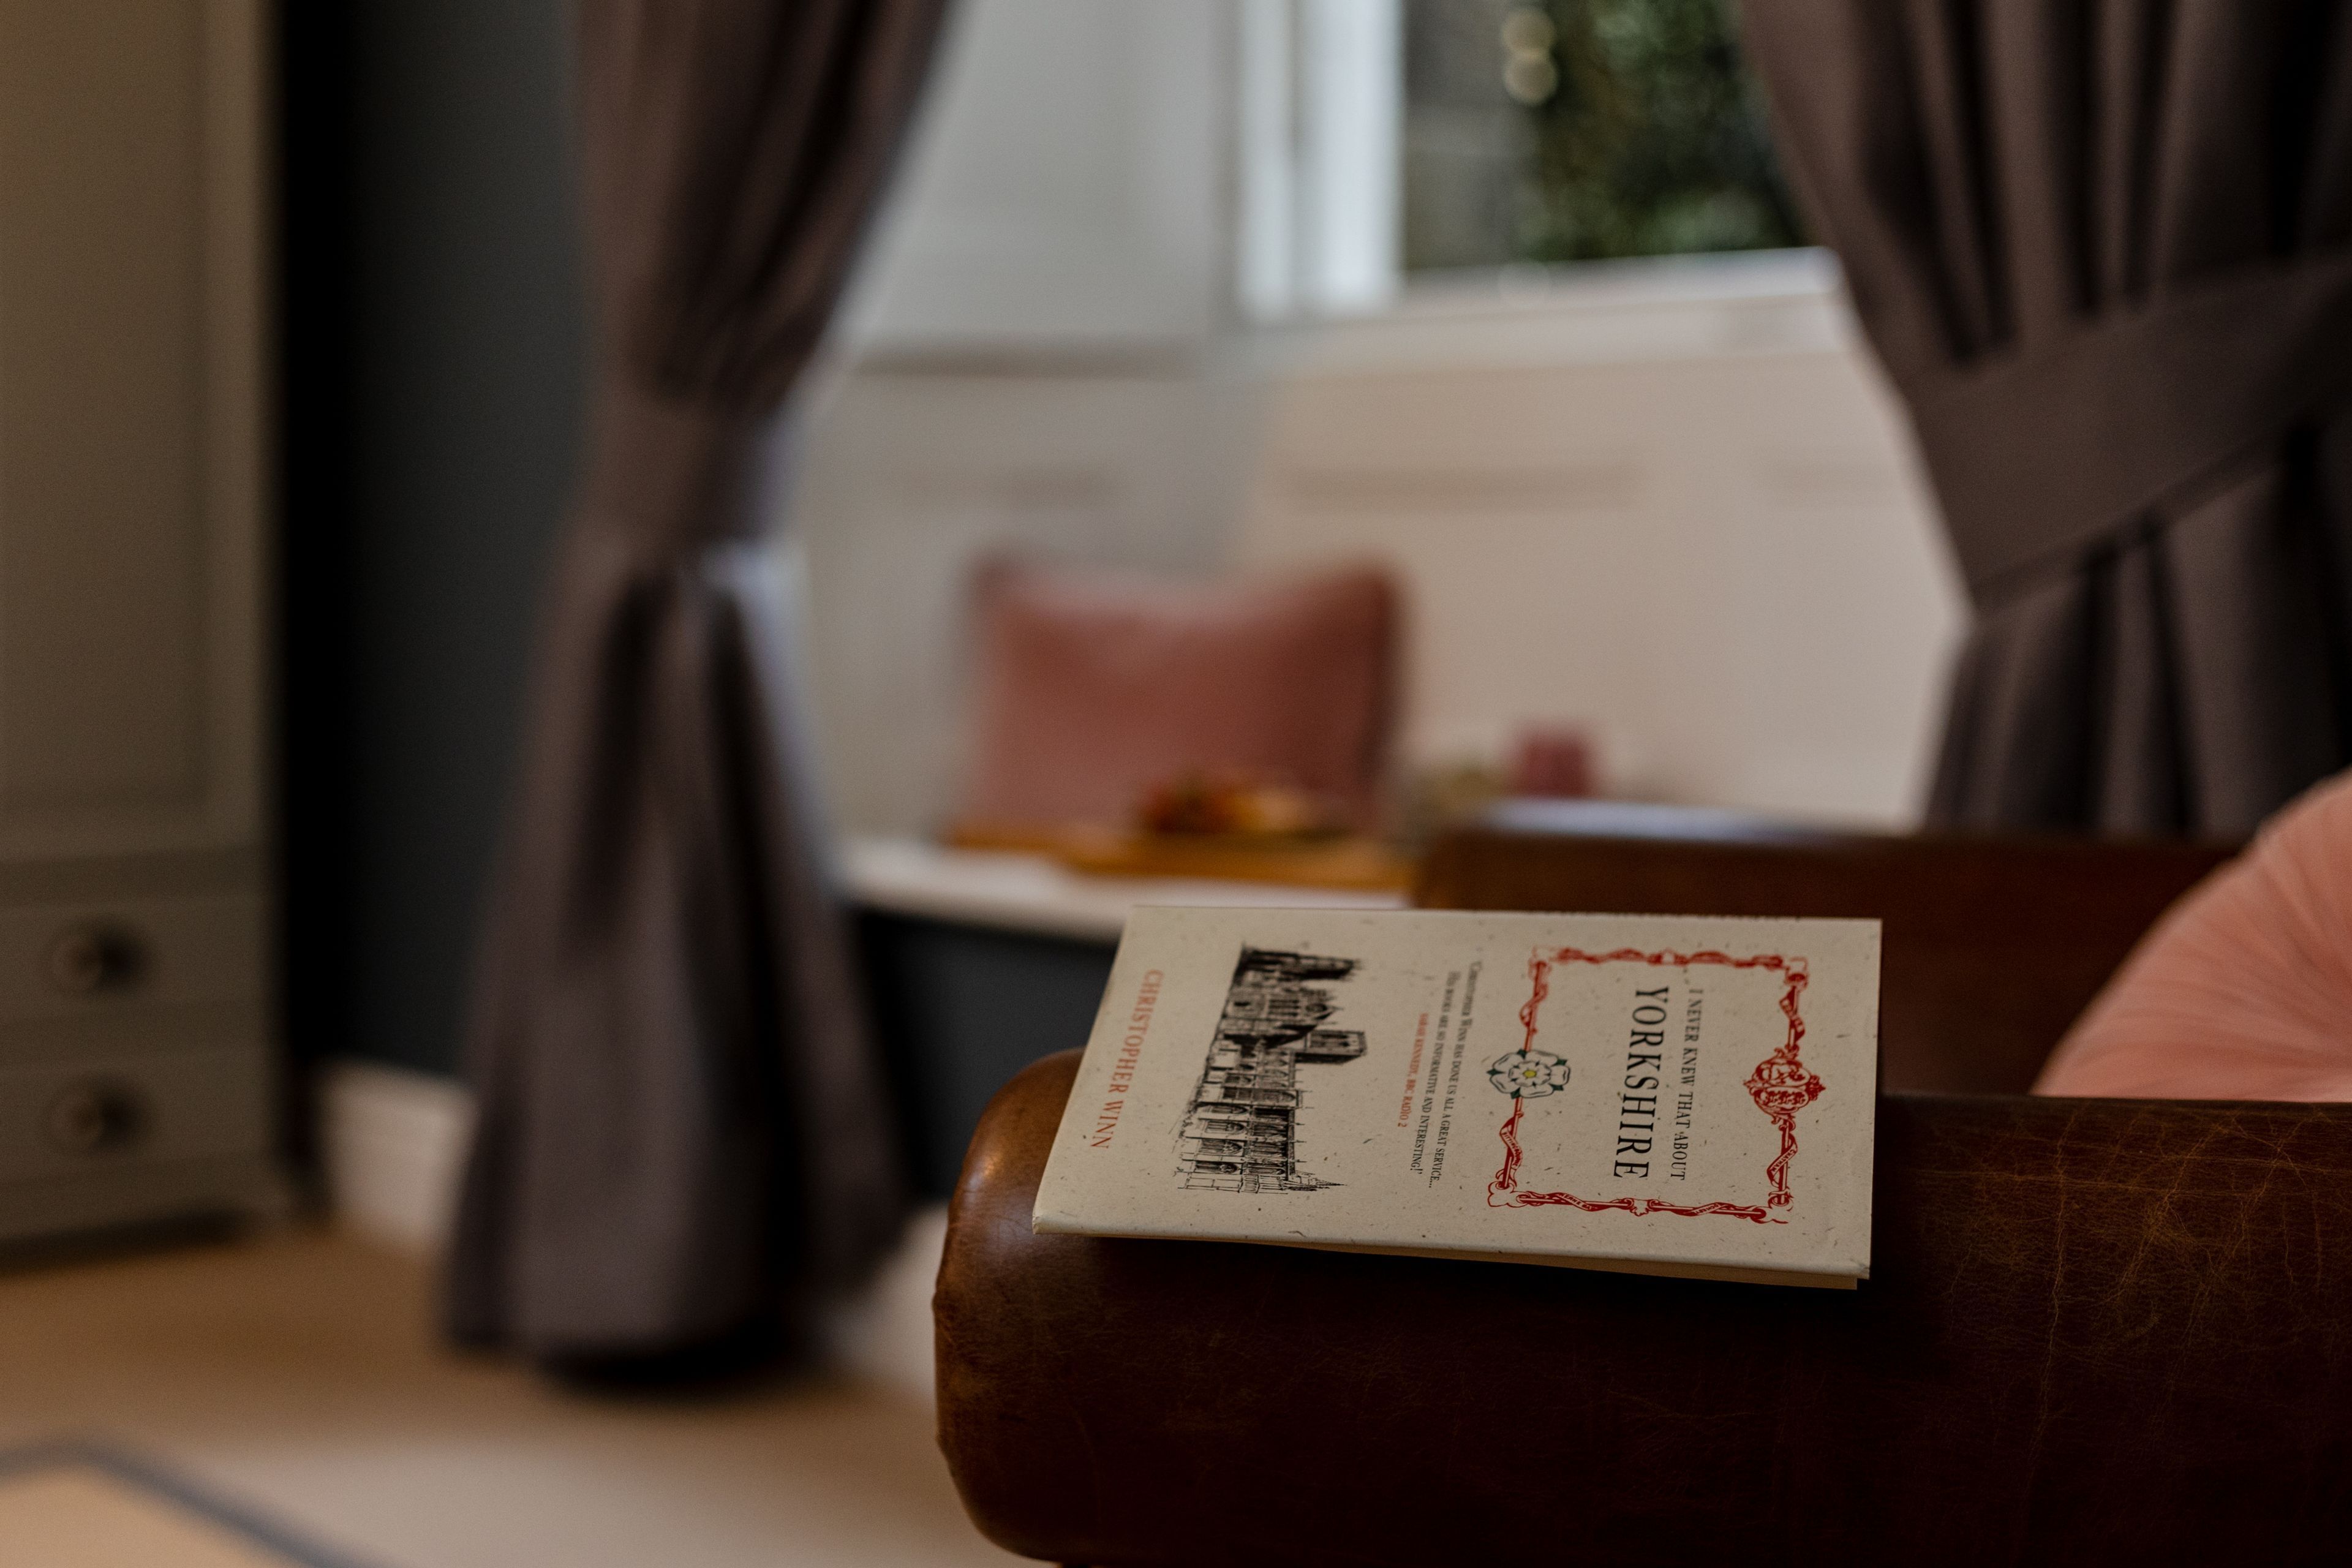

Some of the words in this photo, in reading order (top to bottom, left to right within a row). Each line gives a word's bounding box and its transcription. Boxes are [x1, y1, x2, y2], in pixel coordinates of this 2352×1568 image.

[1108, 970, 1164, 1093] CHRISTOPHER
[1437, 1031, 1446, 1040] SO
[1438, 1015, 1448, 1028] ARE
[1684, 999, 1702, 1042] NEVER
[1408, 1039, 1424, 1076] KENNEDY,
[1453, 1044, 1464, 1058] HAS
[1425, 1042, 1444, 1095] INFORMATIVE
[1449, 1061, 1461, 1082] DONE
[1613, 987, 1669, 1178] YORKSHIRE
[1680, 1047, 1697, 1087] KNEW
[1405, 1079, 1416, 1093] BBC
[1447, 1085, 1457, 1095] US
[1399, 1096, 1412, 1120] RADIO
[1422, 1098, 1432, 1112] AND
[1443, 1097, 1454, 1111] ALL
[1675, 1092, 1693, 1128] THAT
[1091, 1100, 1123, 1148] WINN
[1437, 1120, 1449, 1146] GREAT
[1428, 1148, 1445, 1188] SERVICE...
[1670, 1133, 1688, 1180] ABOUT
